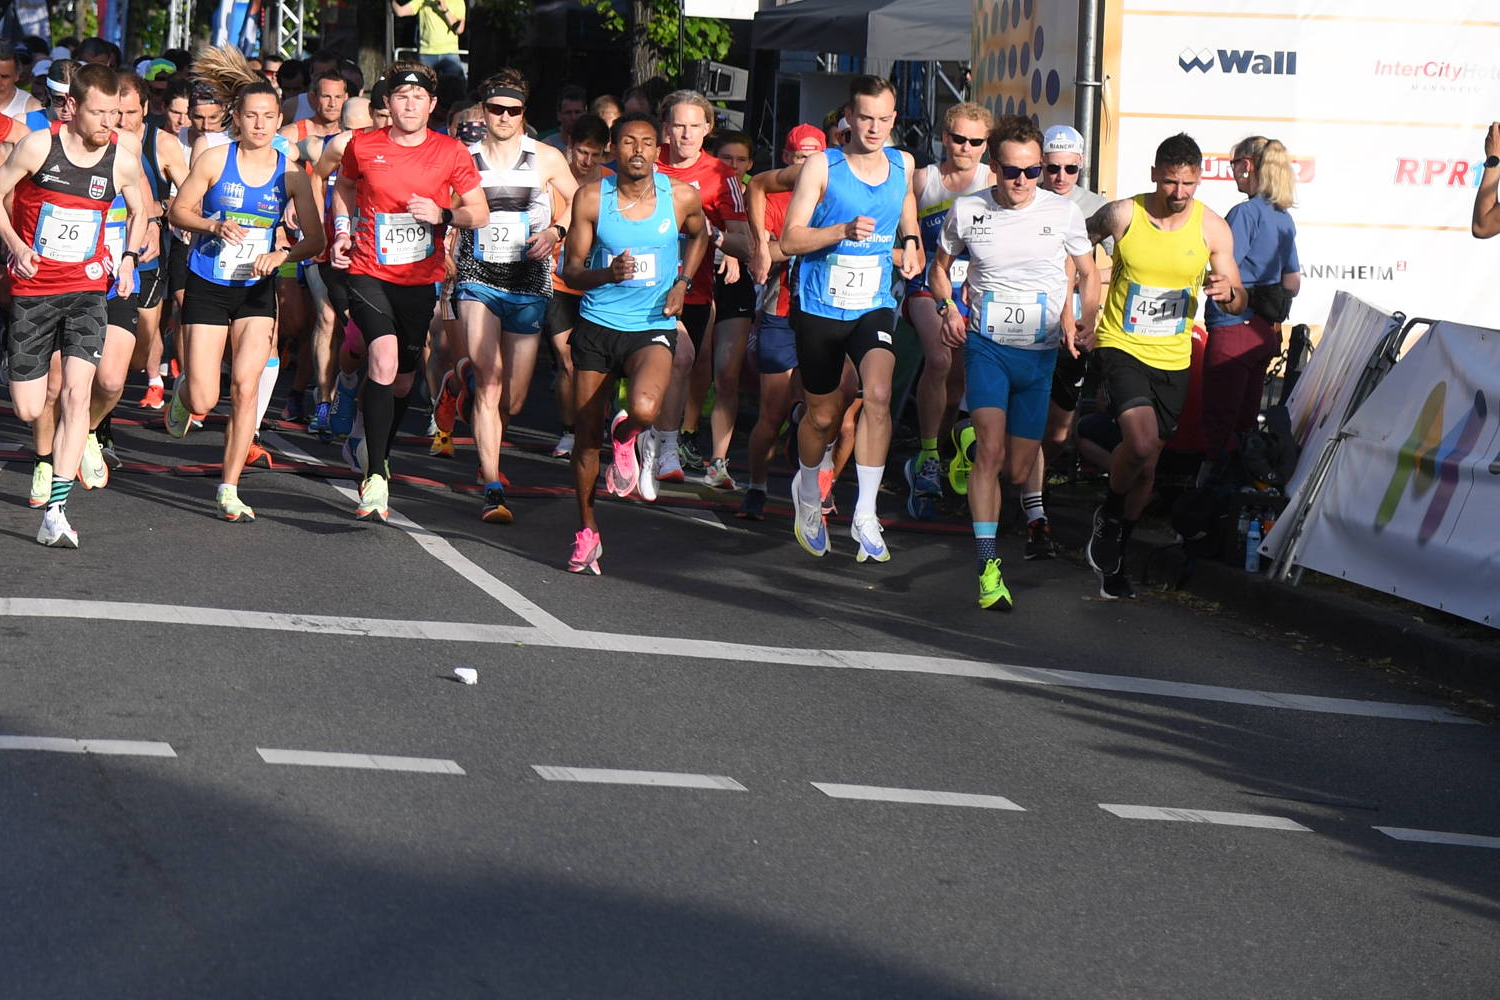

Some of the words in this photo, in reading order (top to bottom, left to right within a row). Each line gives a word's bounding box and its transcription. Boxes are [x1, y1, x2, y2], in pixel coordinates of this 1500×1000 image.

[1217, 49, 1297, 76] Wall
[57, 224, 80, 240] 26
[384, 226, 426, 244] 4509
[491, 227, 509, 242] 32
[235, 243, 255, 259] 27
[845, 271, 864, 288] 21
[1299, 263, 1394, 281] ANNHEIM
[1004, 306, 1025, 324] 20
[1136, 301, 1178, 317] 4511
